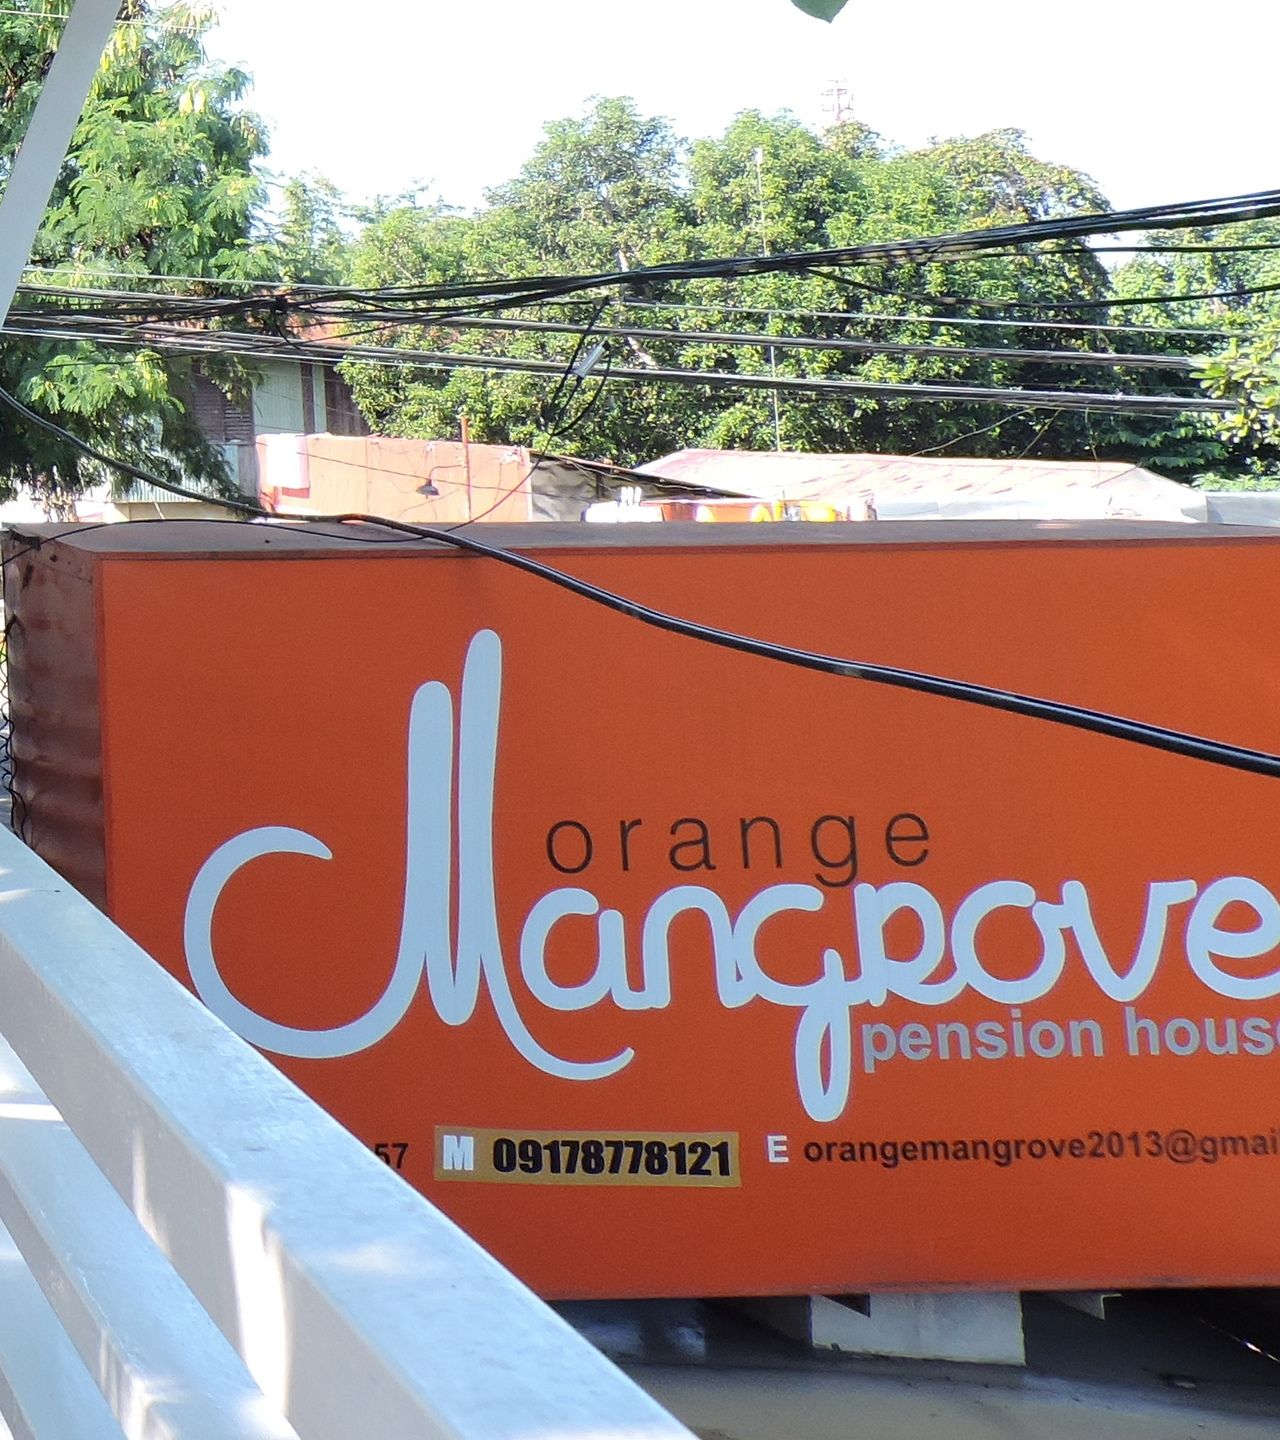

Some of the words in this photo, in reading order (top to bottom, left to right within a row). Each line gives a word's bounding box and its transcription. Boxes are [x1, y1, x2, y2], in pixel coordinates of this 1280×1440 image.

[184, 628, 1280, 1123] Mangrove
[546, 813, 930, 888] orange
[861, 1008, 1104, 1074] pension
[1123, 1006, 1280, 1056] hous
[443, 1135, 474, 1171] M
[492, 1138, 730, 1177] 09178778121
[767, 1135, 789, 1163] E
